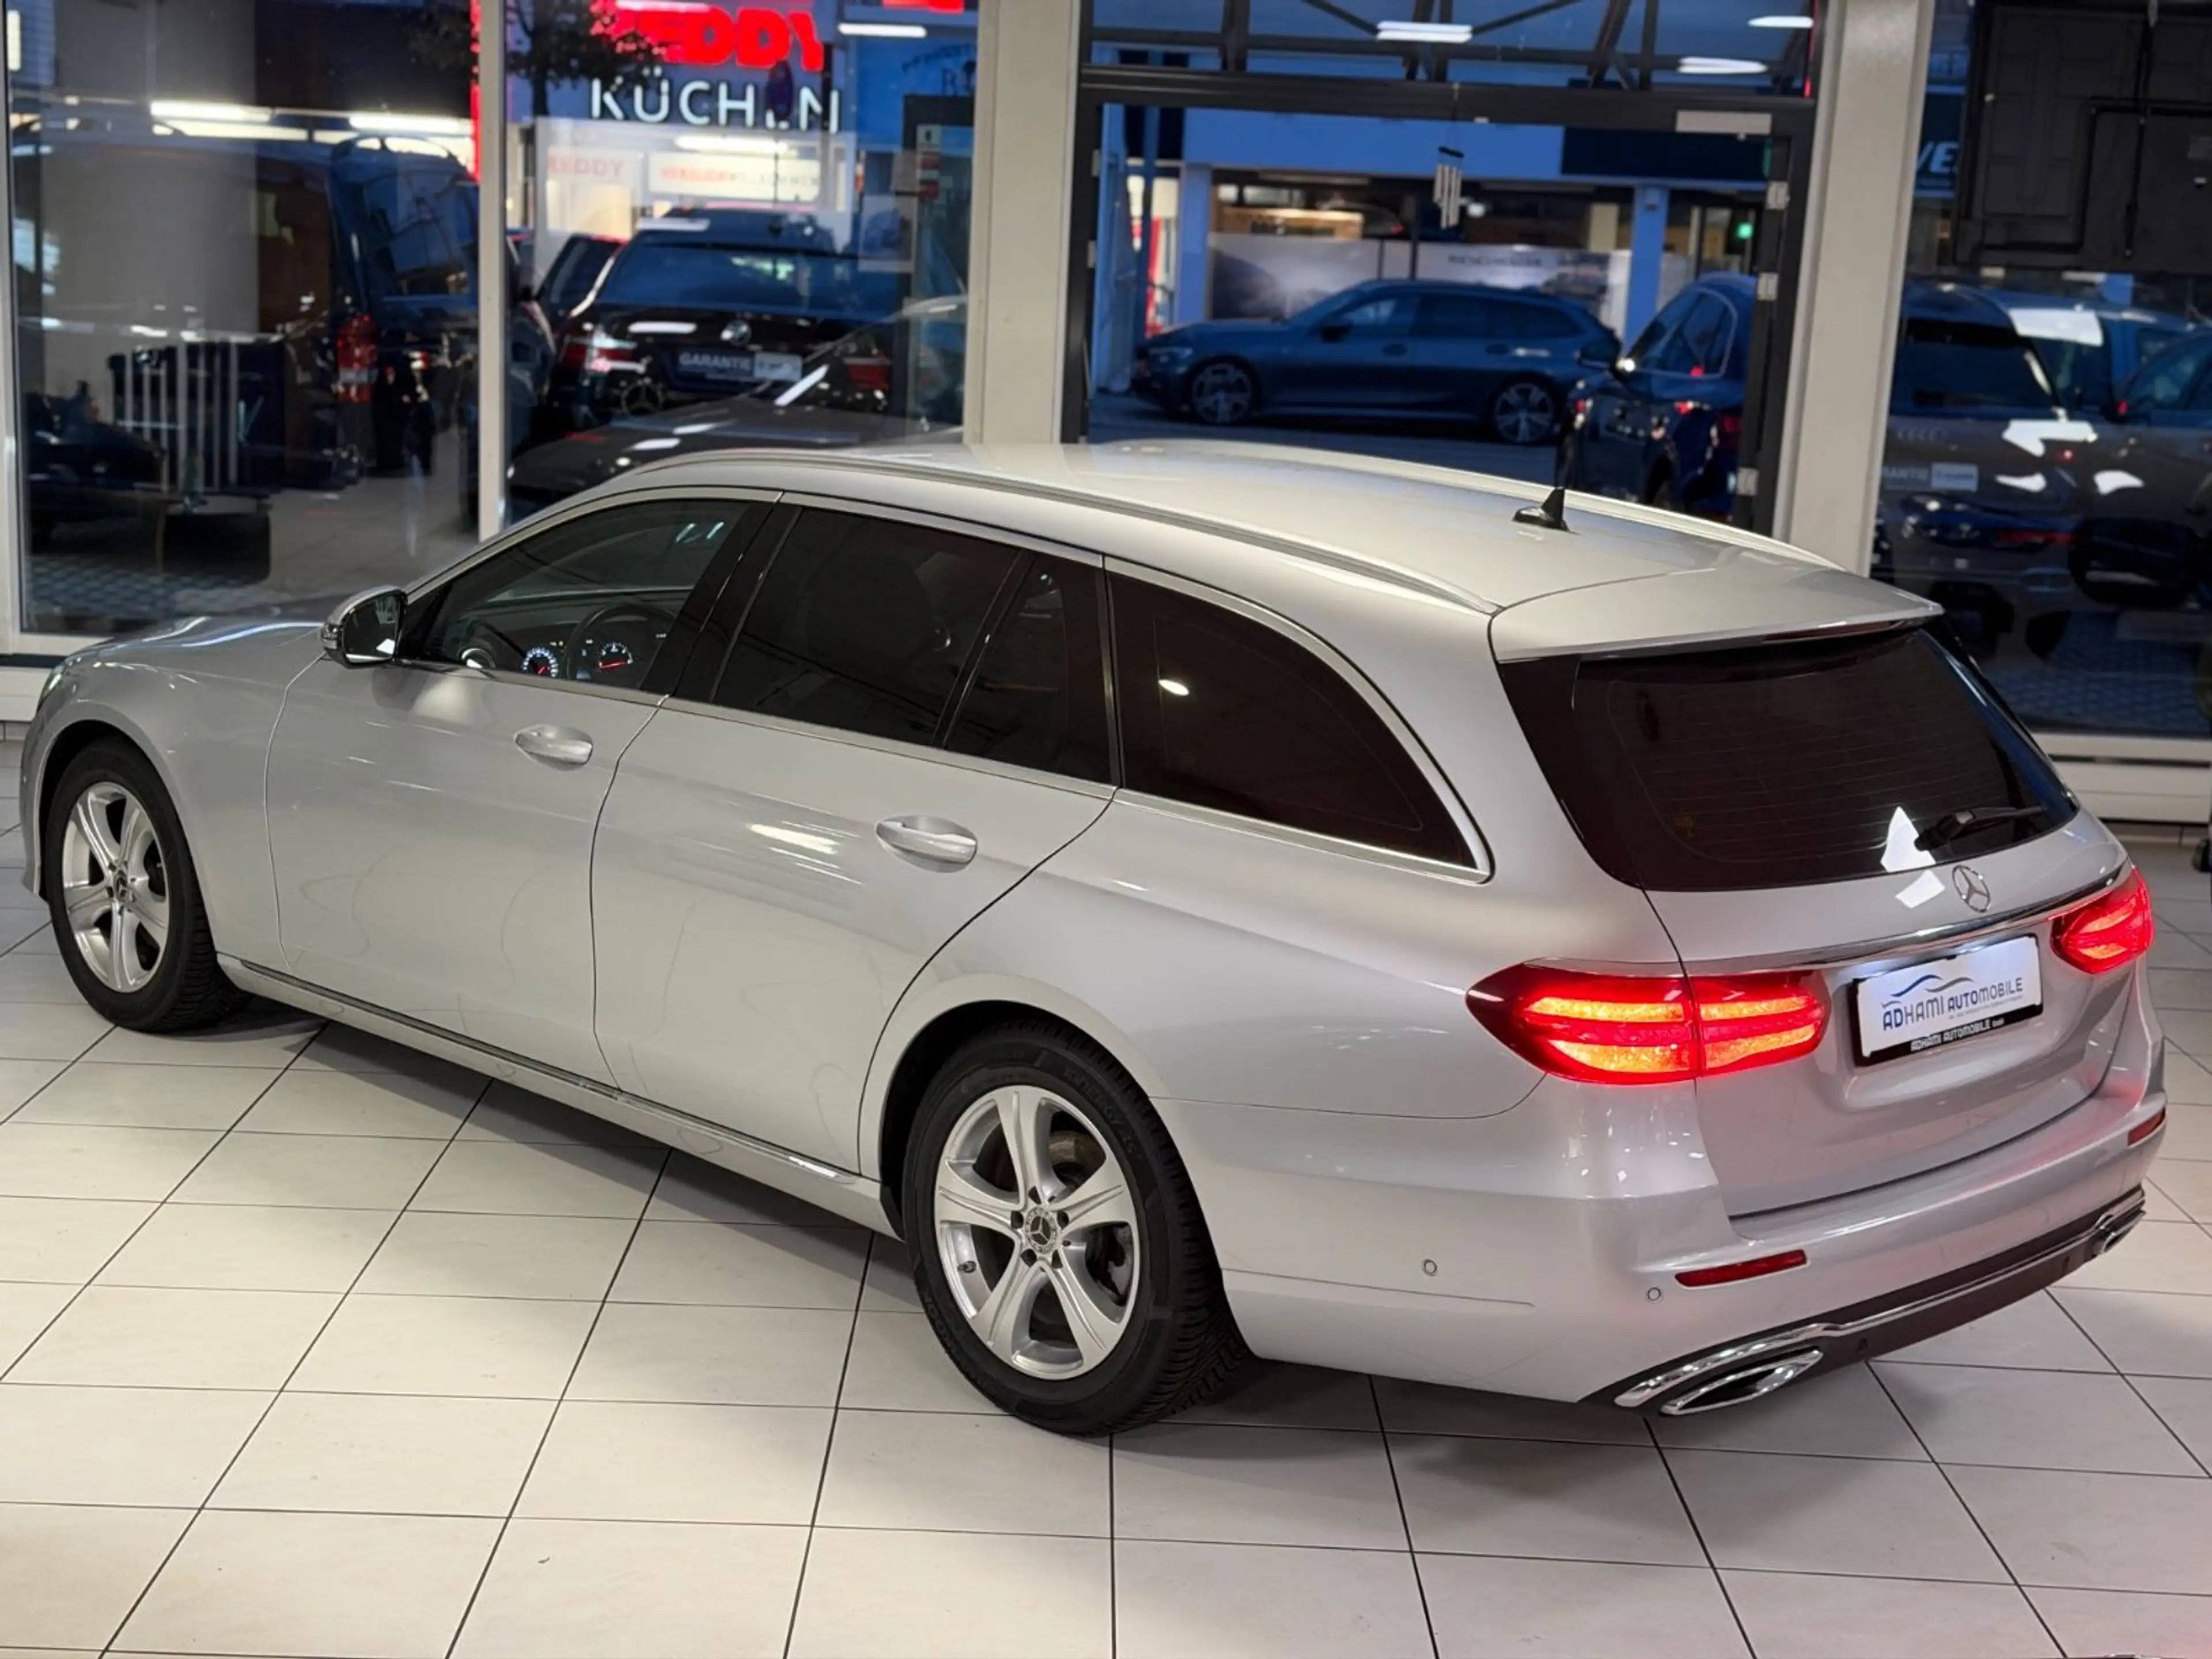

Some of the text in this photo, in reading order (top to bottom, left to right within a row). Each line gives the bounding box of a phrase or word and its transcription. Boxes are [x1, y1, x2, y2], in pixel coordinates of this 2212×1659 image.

[592, 65, 839, 134] KÜCHN
[1883, 995, 1945, 1031] ADHAMI
[1948, 977, 2023, 1012] AUTOMOBILE
